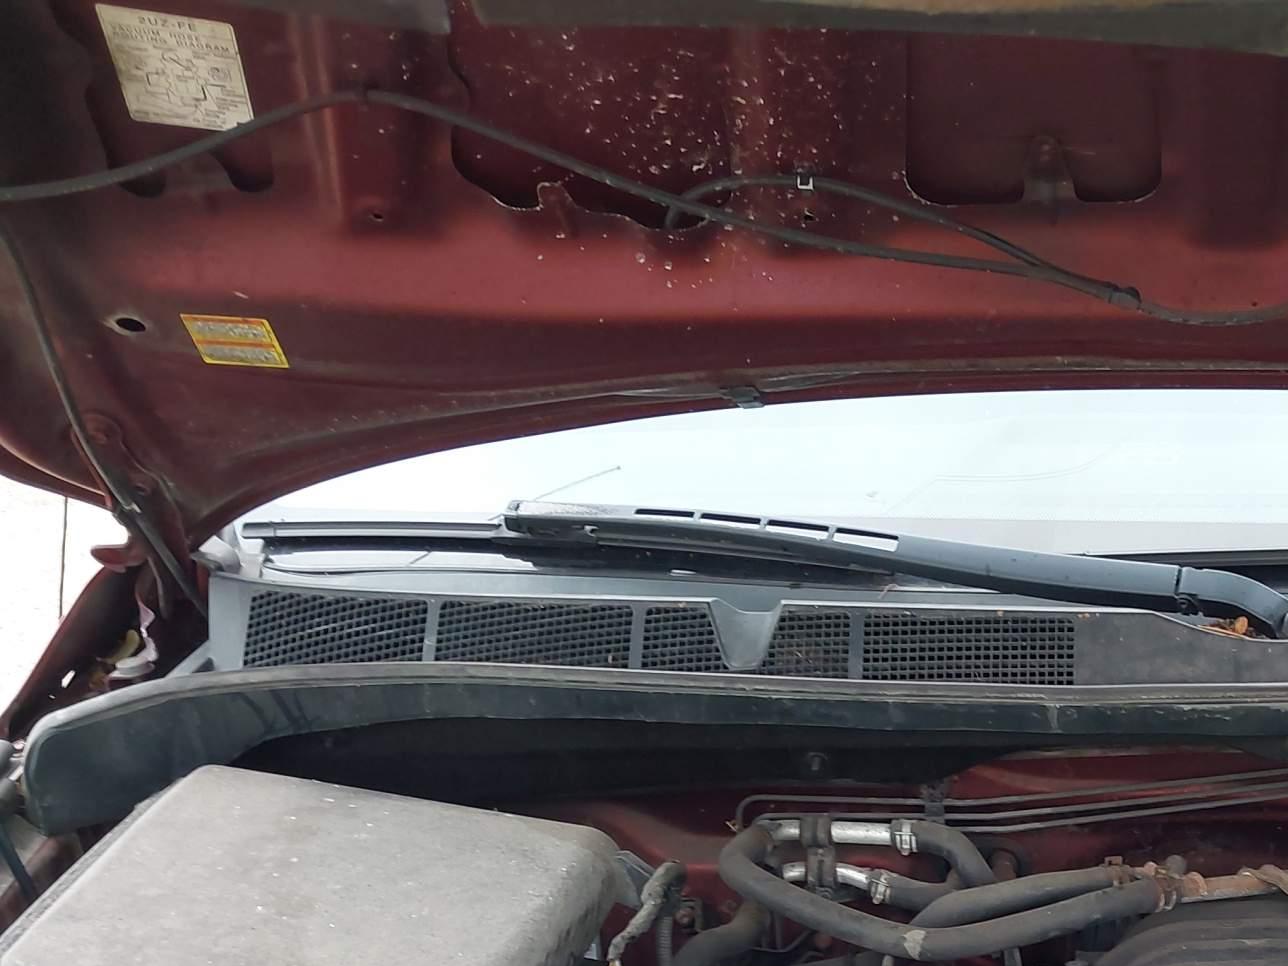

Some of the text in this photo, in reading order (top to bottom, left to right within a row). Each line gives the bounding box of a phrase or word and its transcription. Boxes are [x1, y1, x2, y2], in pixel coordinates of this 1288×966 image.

[111, 23, 200, 42] VACUUM HOSE
[112, 31, 168, 45] ROUTING
[176, 38, 230, 52] DIAGRAM
